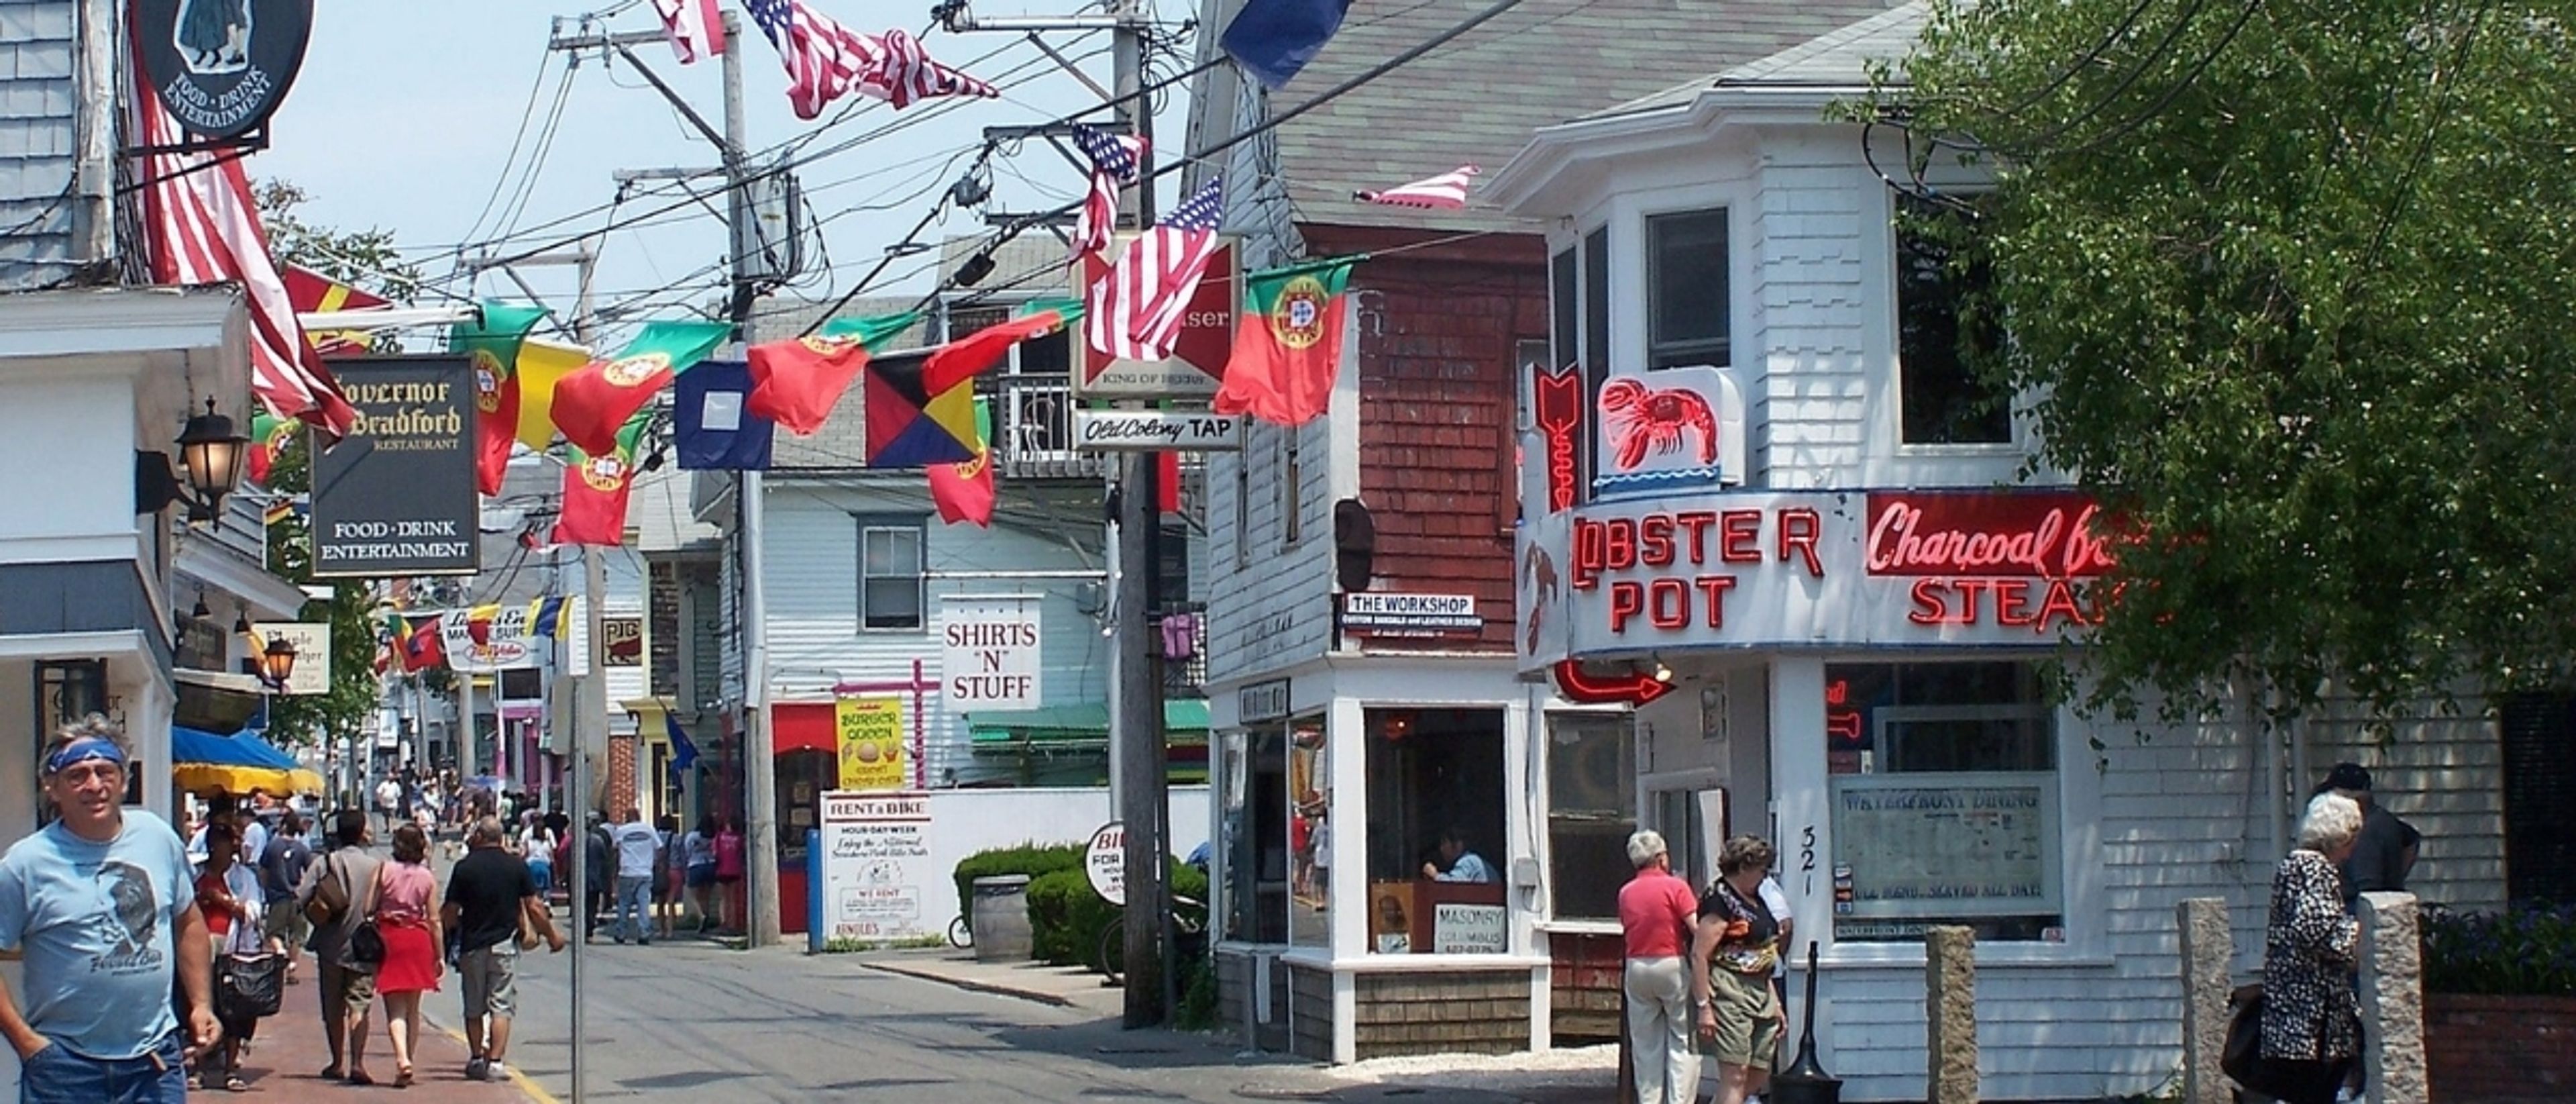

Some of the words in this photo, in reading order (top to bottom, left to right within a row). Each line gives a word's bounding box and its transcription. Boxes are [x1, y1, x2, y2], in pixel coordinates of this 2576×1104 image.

[176, 71, 208, 107] FOOD
[219, 64, 262, 109] DRINK
[164, 72, 271, 128] ENTERTAINMENT
[335, 374, 450, 403] overnor
[1103, 373, 1137, 383] KING
[1140, 374, 1159, 383] OF
[350, 405, 461, 435] Bradford
[1086, 419, 1125, 440] Old
[1121, 419, 1185, 444] Colony
[1189, 419, 1231, 437] TAP
[374, 438, 459, 450] RESTAURANT
[335, 522, 389, 538] FOOD
[397, 521, 457, 536] DRINK
[1867, 501, 2064, 581] Charcoal
[321, 543, 469, 560] ENTERTAINMENT
[1572, 507, 1825, 590] LOBSTER
[1353, 597, 1381, 611] THE
[1385, 597, 1468, 612] WORKSHOP
[1611, 575, 1737, 634] POT
[1909, 578, 2104, 633] STEA
[605, 620, 639, 642] PIG
[947, 623, 1036, 647] SHIRTS
[953, 675, 1032, 699] STUFF
[841, 711, 898, 726] BURGER
[830, 803, 873, 815] RENT
[886, 802, 924, 815] BIKE
[1093, 854, 1120, 865] FOR
[1440, 909, 1502, 925] MASONRY
